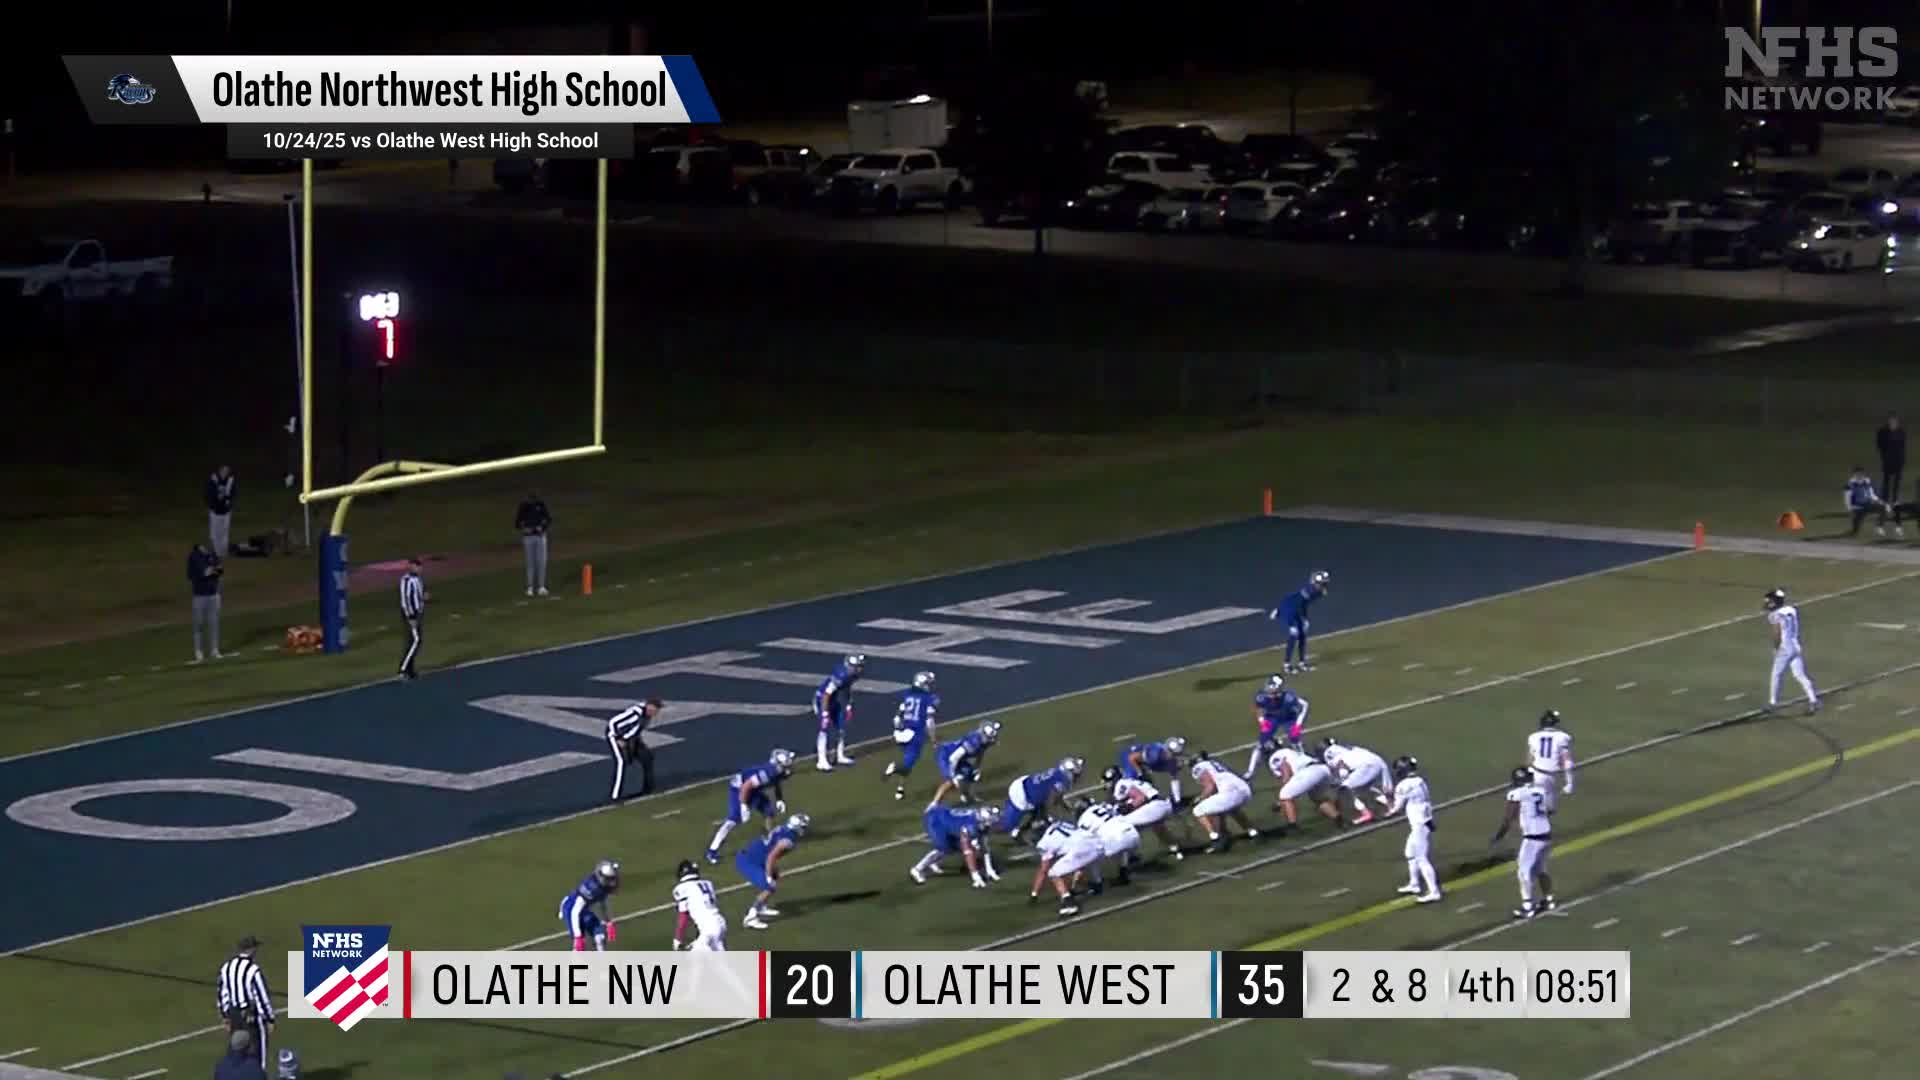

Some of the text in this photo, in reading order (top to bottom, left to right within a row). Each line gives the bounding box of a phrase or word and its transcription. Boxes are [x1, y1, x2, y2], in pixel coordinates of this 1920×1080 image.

[6, 588, 1267, 842] OLATHE
[903, 697, 922, 721] 21
[1540, 737, 1554, 758] 11
